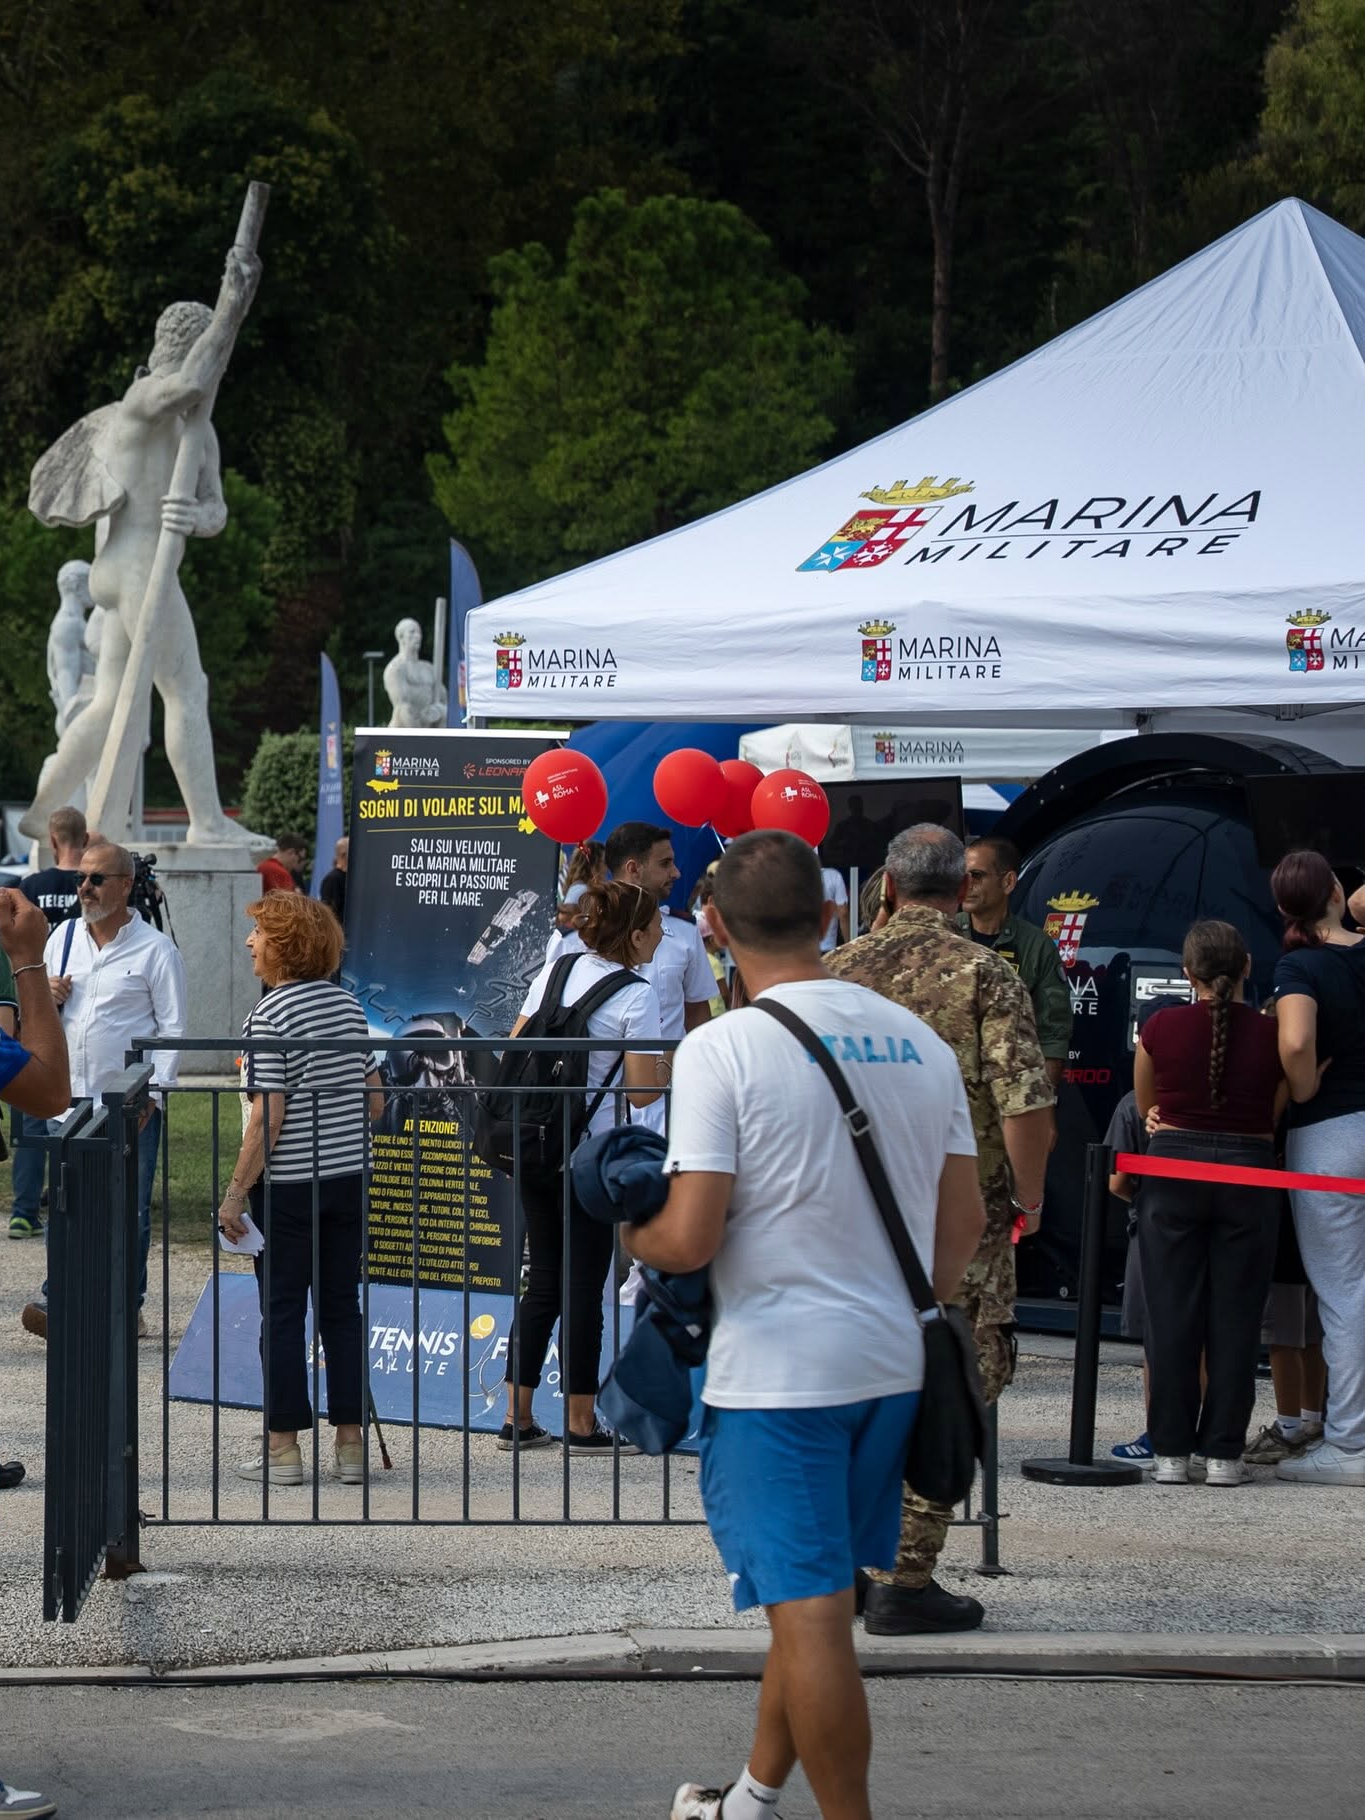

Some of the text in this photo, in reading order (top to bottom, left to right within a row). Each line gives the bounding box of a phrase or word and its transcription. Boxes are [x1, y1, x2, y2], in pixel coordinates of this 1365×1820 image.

[938, 490, 1262, 537] MARINA
[903, 533, 1240, 566] MILITARE
[899, 635, 1002, 659] MARINA
[528, 648, 618, 670] MARINA
[899, 664, 1002, 681] MILITARE
[527, 674, 617, 688] MILITARE
[899, 741, 964, 754] MARINA
[392, 757, 440, 768] MARINA
[899, 755, 964, 764] MILITARE
[392, 769, 440, 777] MILITARE
[478, 767, 526, 776] LEONAR
[552, 784, 564, 793] ASL
[553, 788, 574, 799] ROMA
[359, 799, 400, 819] SOGNI
[404, 798, 418, 818] DI
[422, 796, 475, 816] VOLARE
[478, 796, 505, 816] SUL
[411, 838, 500, 855] SALI SUI VELIVOLI
[391, 855, 517, 873] DELLA MARINA MILITARE
[395, 872, 510, 890] E SCOPRI LA PASSIONE
[419, 890, 483, 906] PER IL MARE.
[807, 1034, 924, 1065] TALIA
[1068, 1050, 1081, 1060] BY
[1062, 1069, 1112, 1084] ARDO
[404, 1120, 459, 1134] ATENZIONE!
[371, 1135, 391, 1144] LATORE
[409, 1137, 441, 1148] SUMENTO
[420, 1165, 445, 1175] PERSONE
[370, 1326, 458, 1356] TENNIS
[373, 1359, 449, 1376] ALUTE
